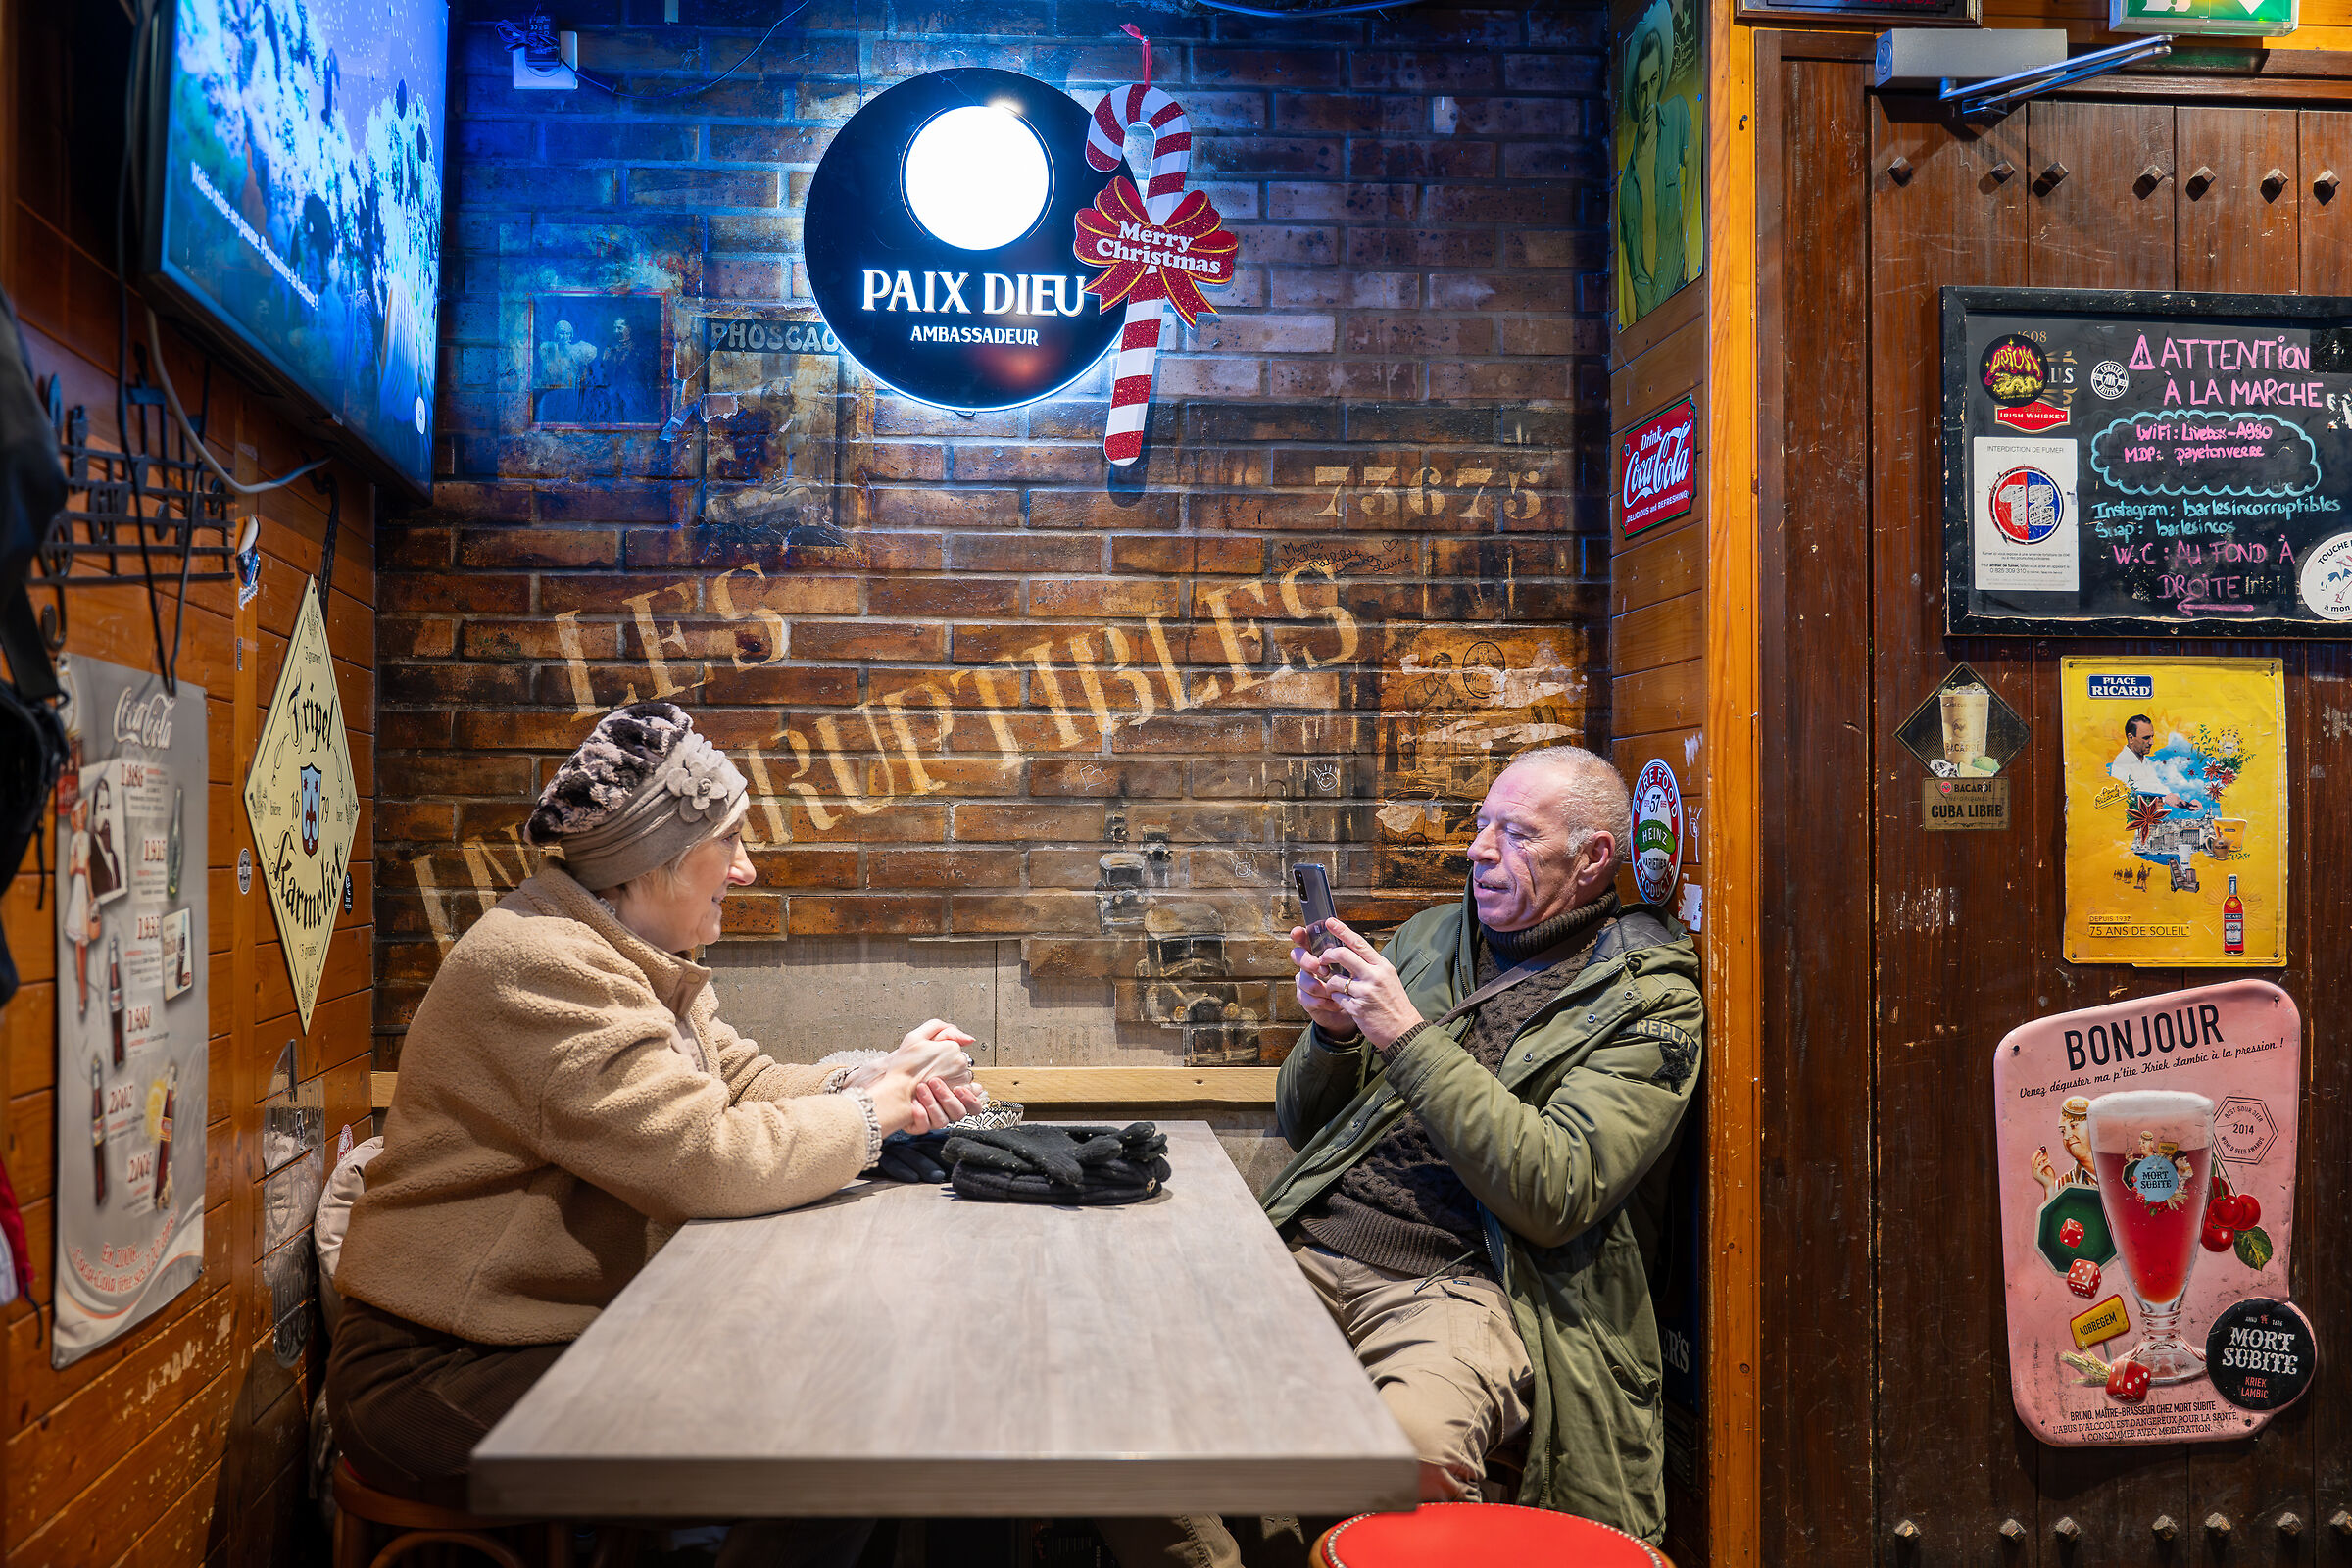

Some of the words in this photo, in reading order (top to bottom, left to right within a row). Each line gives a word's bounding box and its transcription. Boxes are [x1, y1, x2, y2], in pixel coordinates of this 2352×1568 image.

[1118, 220, 1195, 253] Merry
[1096, 238, 1221, 274] Christmas
[862, 270, 971, 314] PAIX
[982, 272, 1087, 317] DIEU
[710, 321, 840, 353] PHOSCAO
[910, 325, 1039, 347] AMBASSADEUR
[2190, 379, 2223, 406] LA
[2230, 378, 2324, 407] MARCHE
[1640, 425, 1663, 452] Drink
[1314, 466, 1541, 520] 73675
[1627, 507, 1650, 523] DELICIOUS
[1658, 490, 1689, 510] REFRESHING
[2209, 540, 2267, 564] FOND
[2278, 534, 2295, 564] À
[2318, 540, 2349, 565] TOUCHE
[555, 563, 790, 721] LES
[2091, 685, 2150, 696] RICARD
[2102, 676, 2136, 685] PLACE
[287, 666, 336, 755] Tripel
[411, 564, 1358, 941] INRUPTIBLES
[1635, 768, 1655, 814] PURE
[1656, 768, 1678, 818] FOOD
[1649, 794, 1662, 813] 57
[290, 791, 300, 822] 16
[321, 795, 330, 823] 79
[1931, 805, 1964, 818] CUBA
[1968, 805, 2004, 818] LIBRE
[1642, 827, 1668, 846] HEINZ
[1642, 857, 1667, 871] VARIETIES
[267, 825, 343, 930] Karmeliet
[1636, 861, 1674, 898] PRODUCTS
[2089, 926, 2103, 936] 75
[2106, 926, 2129, 936] ANS
[2132, 926, 2146, 936] DE
[1636, 1019, 1692, 1052] REPLAY
[2064, 1004, 2224, 1071] BONJOUR
[2020, 1087, 2046, 1099] Venez
[2049, 1077, 2091, 1093] déguster
[2094, 1074, 2110, 1083] ma
[2141, 1059, 2170, 1074] Kriek
[2173, 1053, 2209, 1068] Lambic
[2211, 1050, 2220, 1060] à
[2222, 1049, 2233, 1058] la
[2235, 1041, 2278, 1058] pression
[2224, 1107, 2236, 1118] BEST
[2232, 1124, 2254, 1135] 2014
[2221, 1136, 2234, 1152] WORLD
[2248, 1136, 2265, 1153] AWARDS
[2140, 1180, 2172, 1189] SUBITE
[2142, 1171, 2169, 1180] MORT
[2079, 1311, 2117, 1337] KOBBEGEM
[2229, 1326, 2295, 1352] MORT
[2222, 1348, 2299, 1375] SUBITE
[2241, 1387, 2269, 1399] LAMBIC
[2244, 1376, 2267, 1388] KRIEK
[2156, 1403, 2173, 1414] CHEZ
[2174, 1402, 2192, 1413] MORT
[2192, 1400, 2216, 1411] SUBITE
[2053, 1423, 2078, 1435] L'ABUS
[2078, 1420, 2116, 1433] D'ALCOOL
[2117, 1418, 2130, 1429] EST
[2131, 1416, 2178, 1428] DANGEREUX
[2179, 1414, 2199, 1425] POUR
[2201, 1413, 2212, 1422] LA
[2087, 1429, 2136, 1442] CONSOMMER
[2136, 1427, 2157, 1437] AVEC
